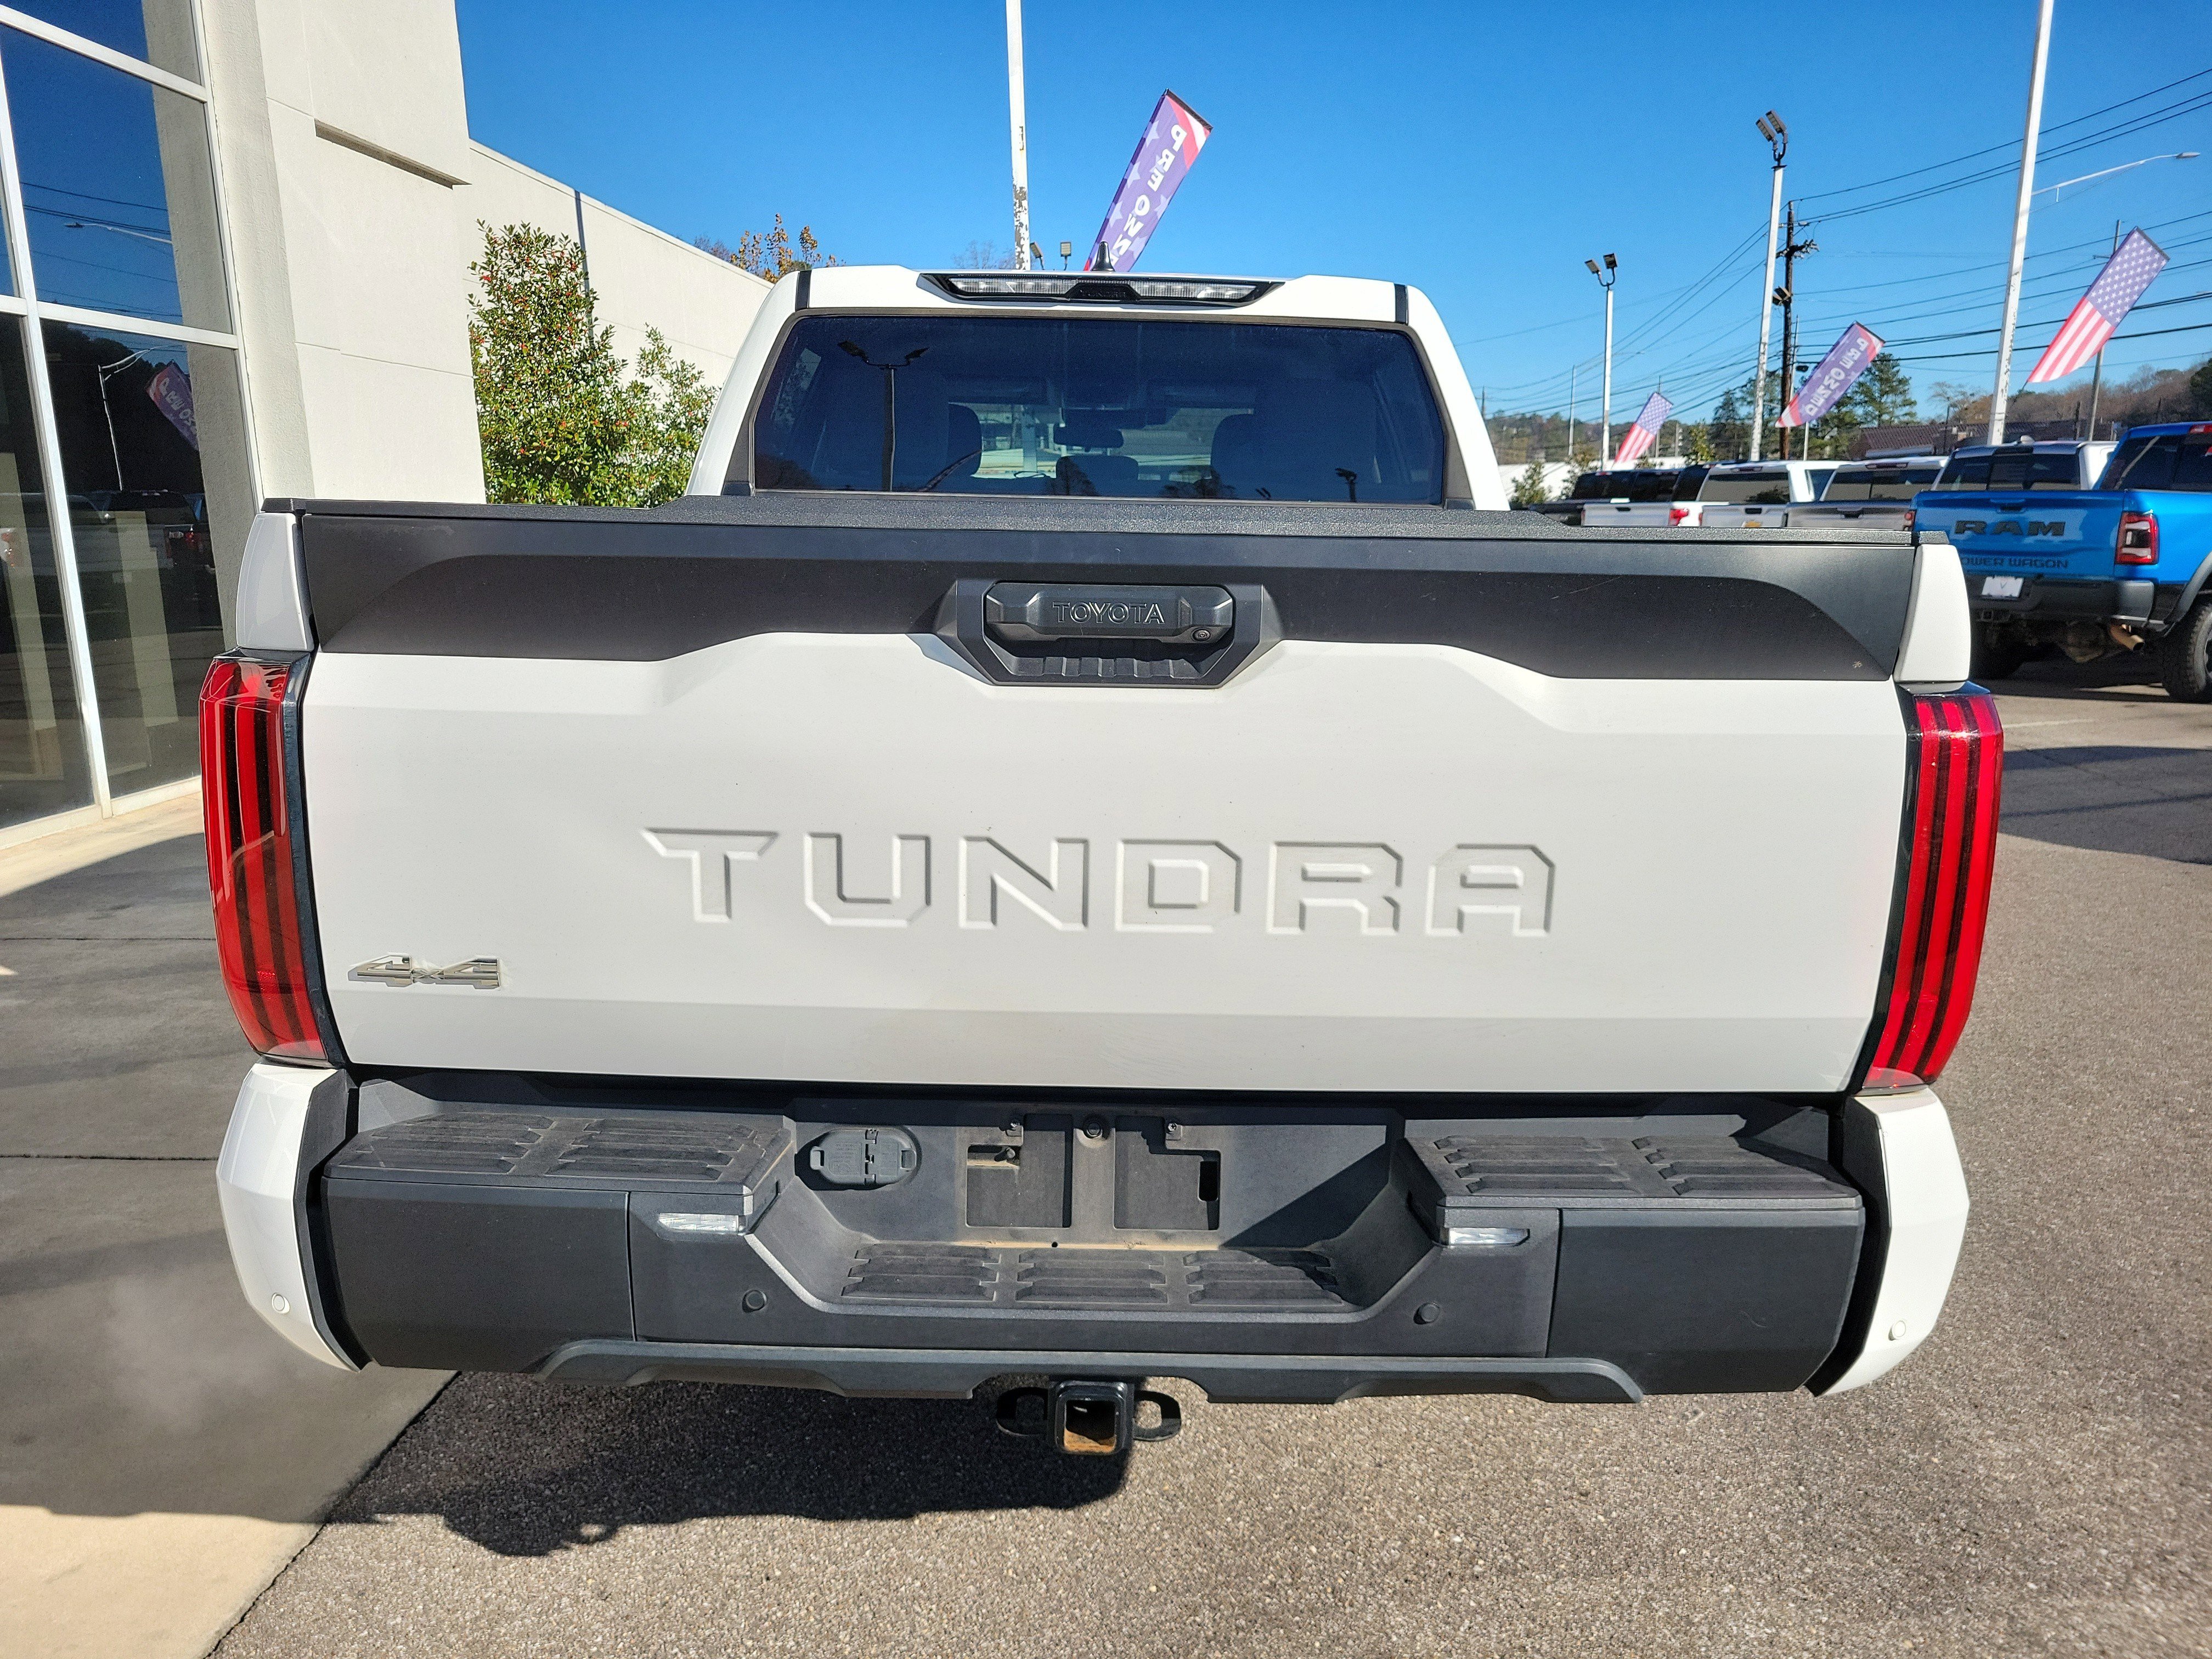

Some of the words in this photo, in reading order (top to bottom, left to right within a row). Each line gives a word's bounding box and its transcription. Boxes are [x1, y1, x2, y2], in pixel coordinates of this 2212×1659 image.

[1955, 521, 2066, 536] RAM
[1961, 557, 2004, 566] OWER
[2007, 558, 2068, 568] WAGON
[1052, 602, 1165, 624] TOYOTA
[640, 827, 1555, 936] TUNDRA
